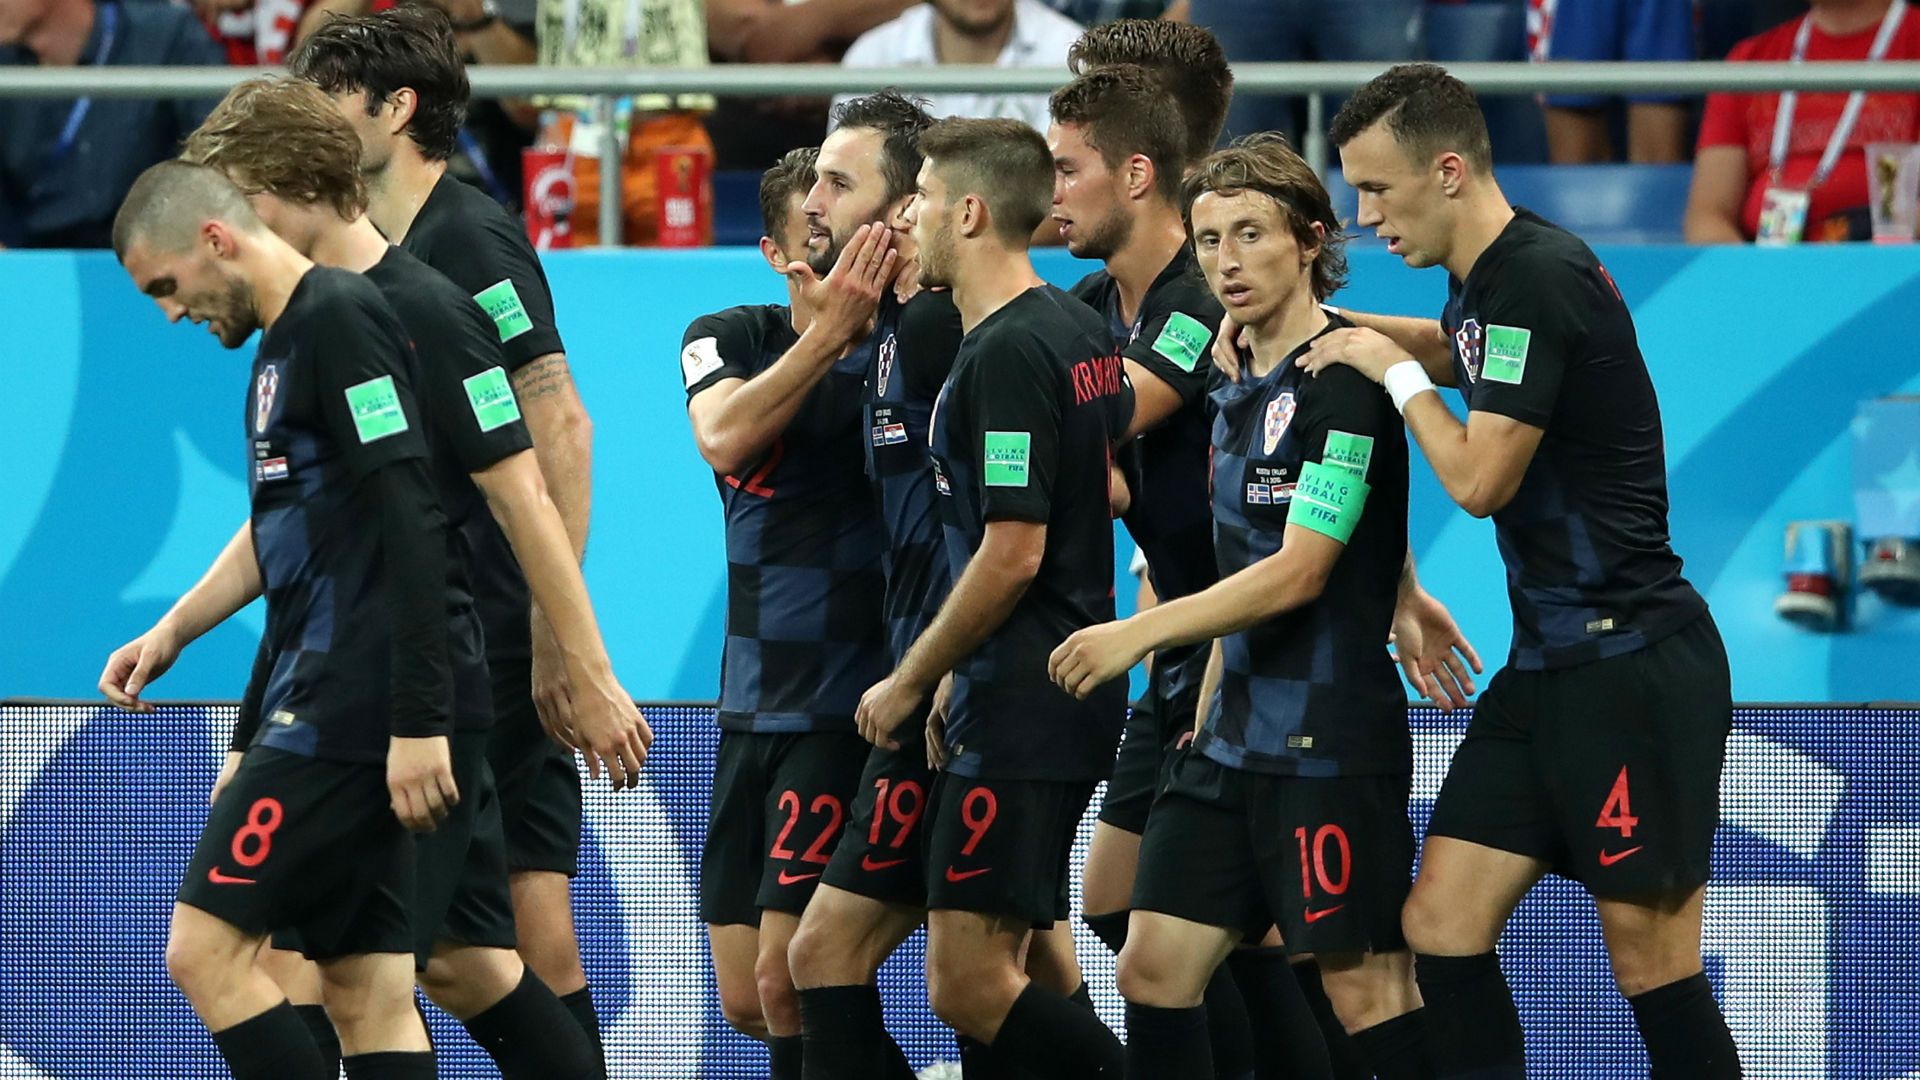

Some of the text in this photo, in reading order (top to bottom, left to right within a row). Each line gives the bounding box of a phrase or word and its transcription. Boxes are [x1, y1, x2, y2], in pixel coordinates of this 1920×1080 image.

[1298, 483, 1345, 506] OTBALL
[1305, 473, 1349, 497] VING
[1310, 507, 1338, 525] FIFA
[232, 797, 283, 867] 8
[769, 790, 843, 865] 22
[868, 778, 924, 848] 19
[961, 786, 997, 856] 9
[1595, 764, 1640, 837] 4
[1295, 823, 1351, 898] 10
